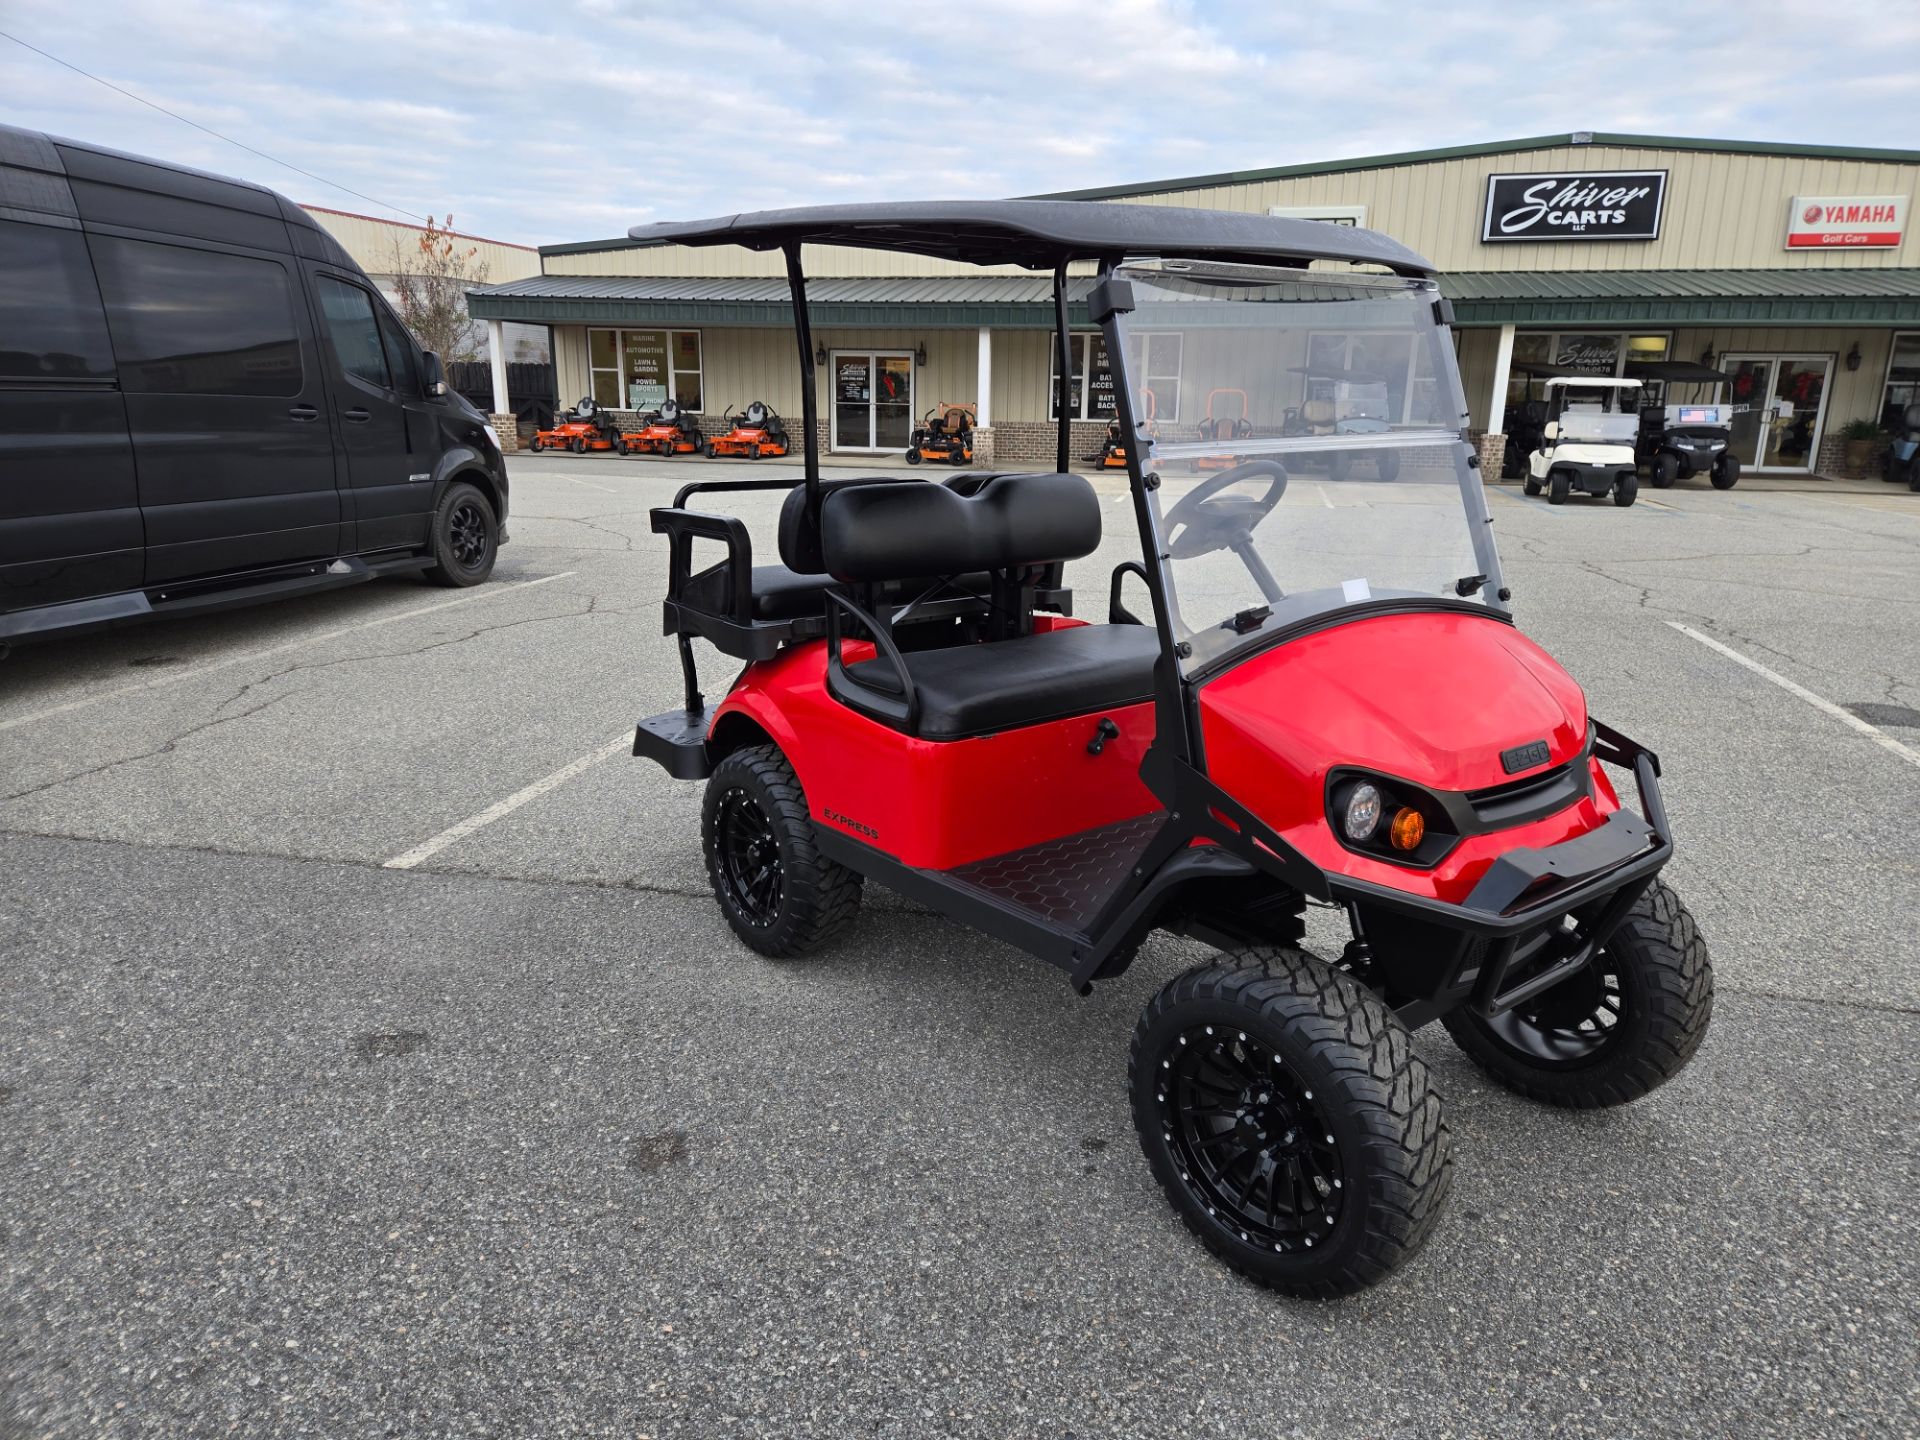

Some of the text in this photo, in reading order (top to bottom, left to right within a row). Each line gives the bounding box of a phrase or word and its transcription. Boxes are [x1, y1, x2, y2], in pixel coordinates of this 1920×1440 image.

[1500, 179, 1650, 233] Shiver
[1825, 205, 1895, 223] YAMAHA
[1547, 209, 1626, 225] CARTS
[1822, 234, 1868, 243] Golf Cars
[626, 346, 664, 354] AUTOMOTIVE
[823, 808, 879, 839] EXPRESS
